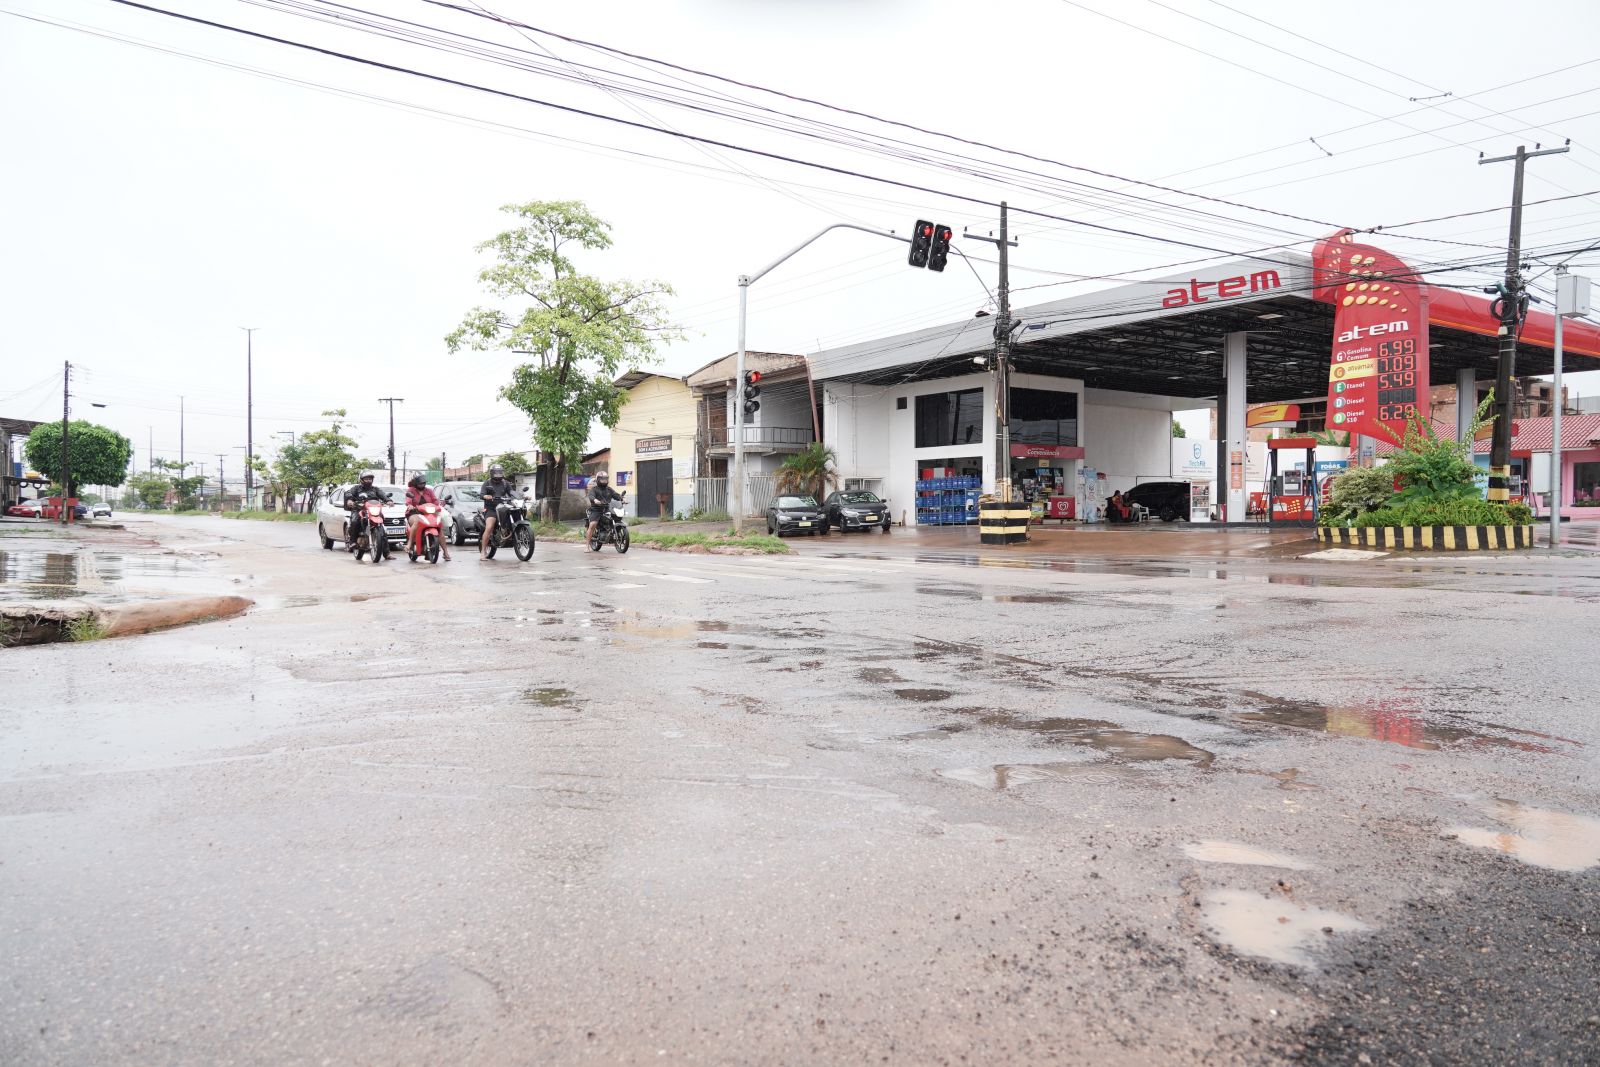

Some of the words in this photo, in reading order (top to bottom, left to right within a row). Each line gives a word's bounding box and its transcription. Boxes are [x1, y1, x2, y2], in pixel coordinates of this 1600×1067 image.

[1162, 269, 1281, 308] atem
[1337, 320, 1409, 343] atem
[1346, 347, 1372, 355] Gasolina
[1380, 340, 1414, 357] 6.99
[1380, 357, 1414, 372] 7.09
[1380, 372, 1414, 389] 5.49
[1346, 397, 1365, 405] Diesel
